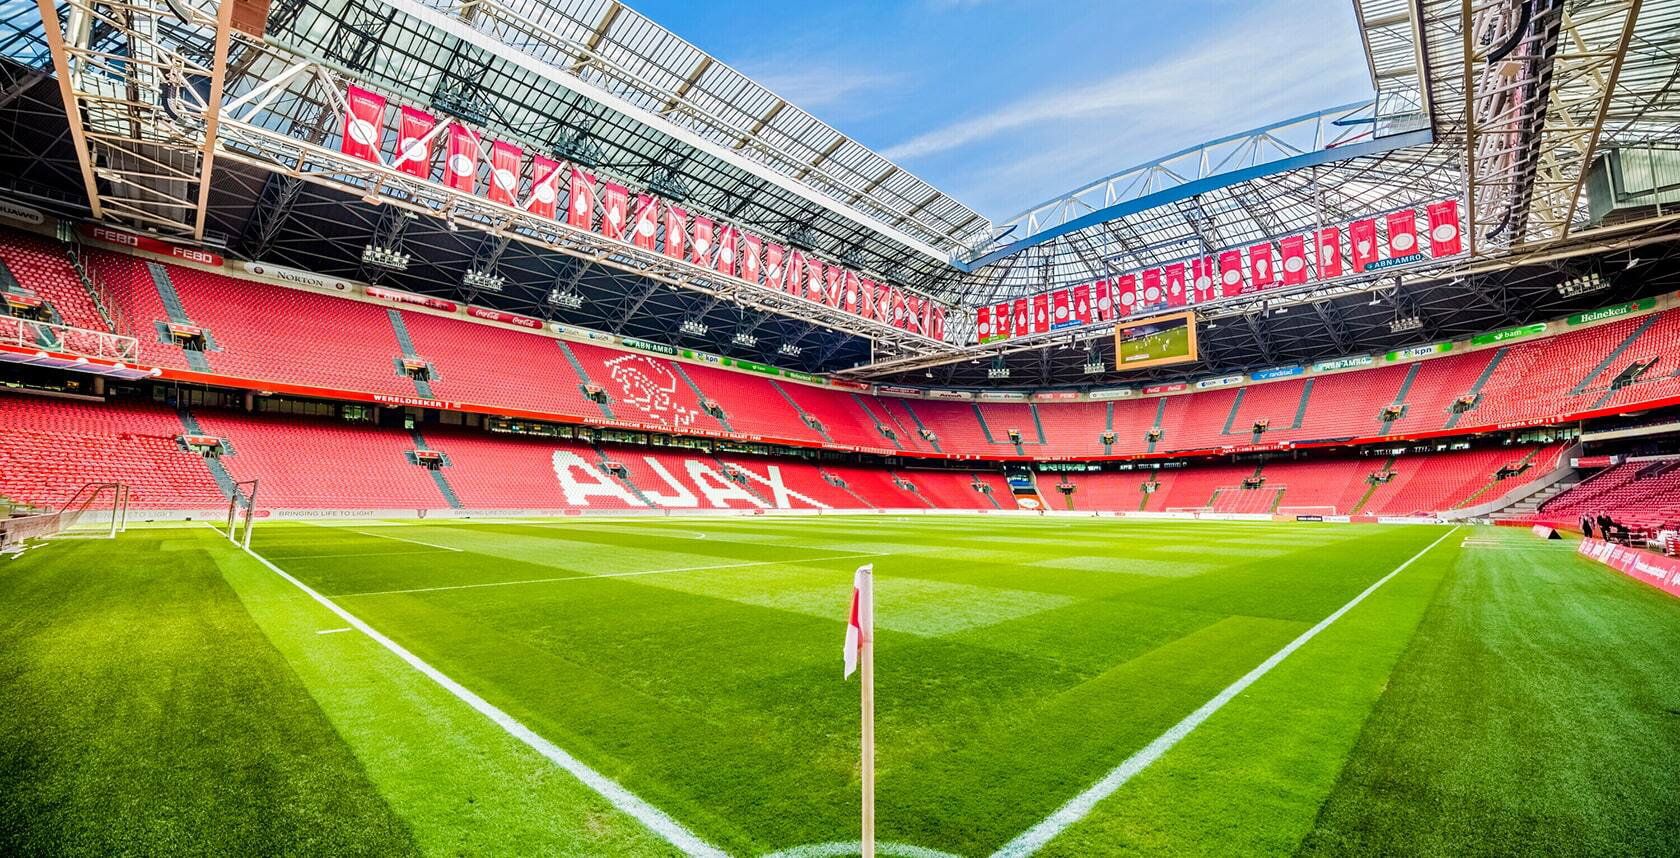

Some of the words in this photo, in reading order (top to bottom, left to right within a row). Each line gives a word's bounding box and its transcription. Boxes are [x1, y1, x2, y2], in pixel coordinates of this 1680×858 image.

[93, 227, 138, 246] FEBO
[173, 246, 213, 264] FEBO
[1581, 306, 1627, 322] Heineken
[1504, 330, 1522, 338] bam
[1415, 347, 1432, 355] kpn
[706, 355, 718, 363] kpn
[373, 395, 442, 408] WERELDBEKER
[1498, 421, 1526, 430] EUROPA
[552, 450, 833, 509] AJAX
